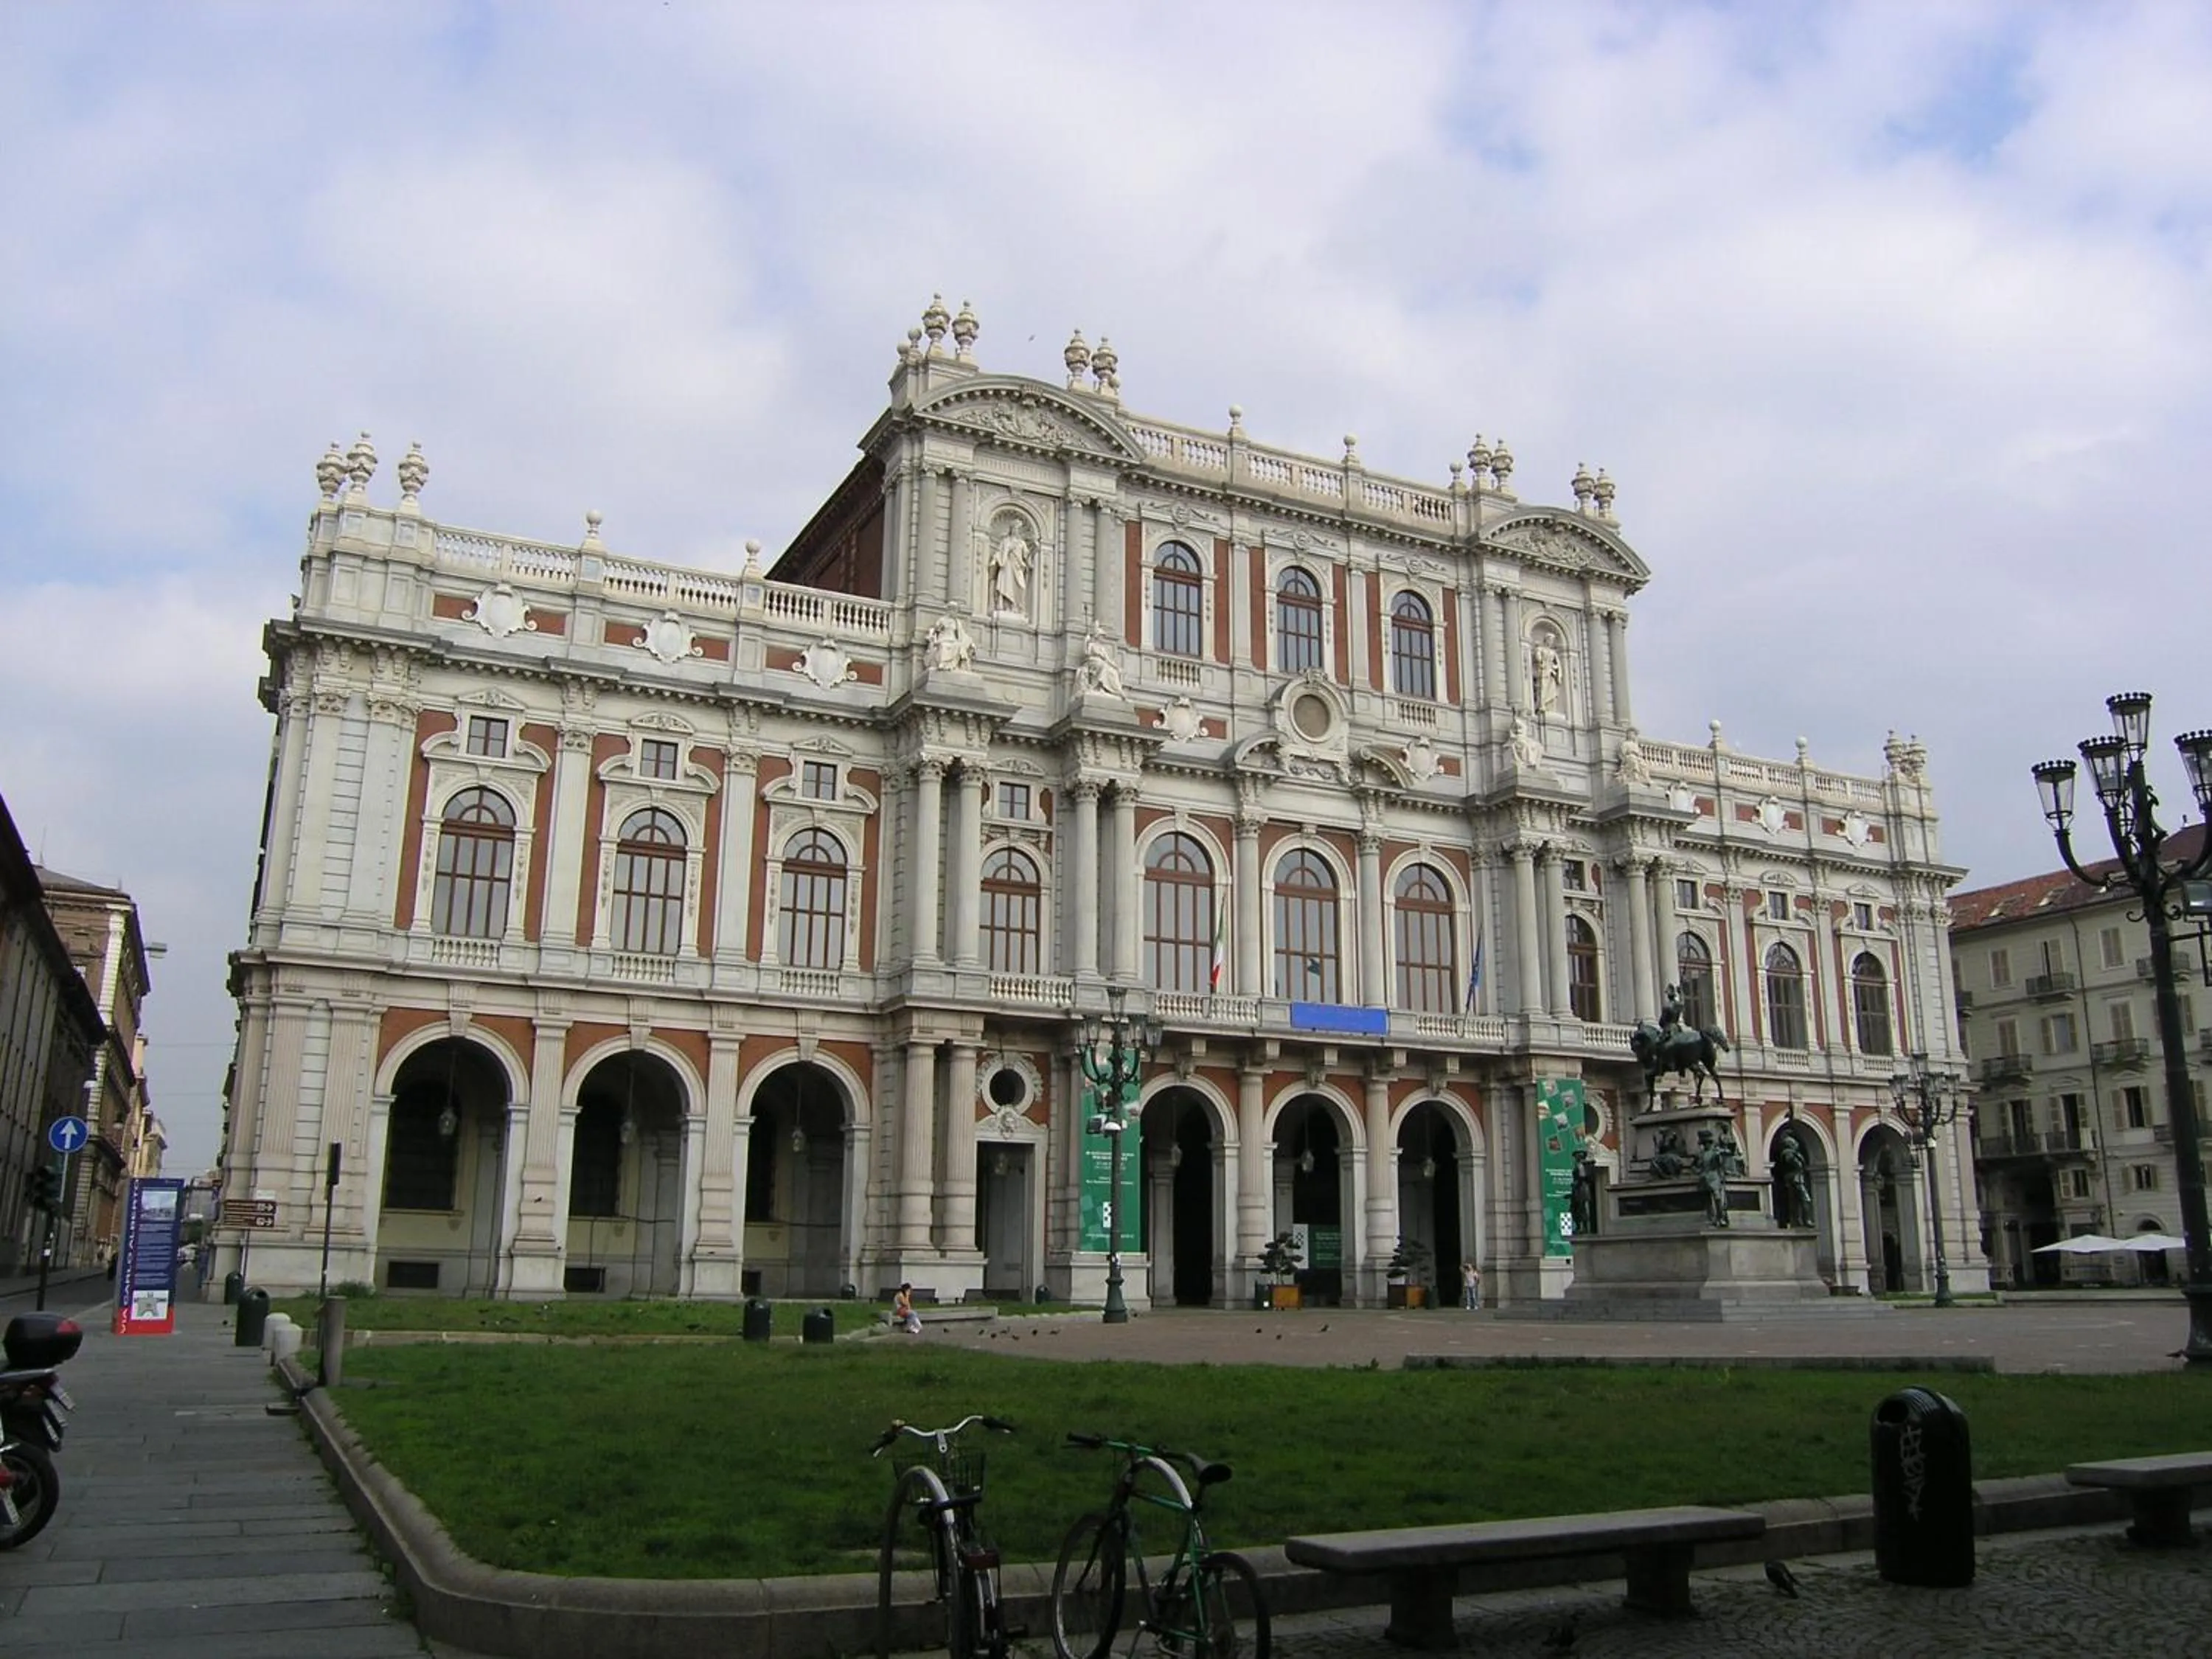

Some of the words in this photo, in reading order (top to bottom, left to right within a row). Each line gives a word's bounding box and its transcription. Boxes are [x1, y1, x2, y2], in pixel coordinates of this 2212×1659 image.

[128, 1179, 139, 1250] ALBERTO
[123, 1251, 133, 1306] CARLO
[120, 1308, 128, 1333] VIA
